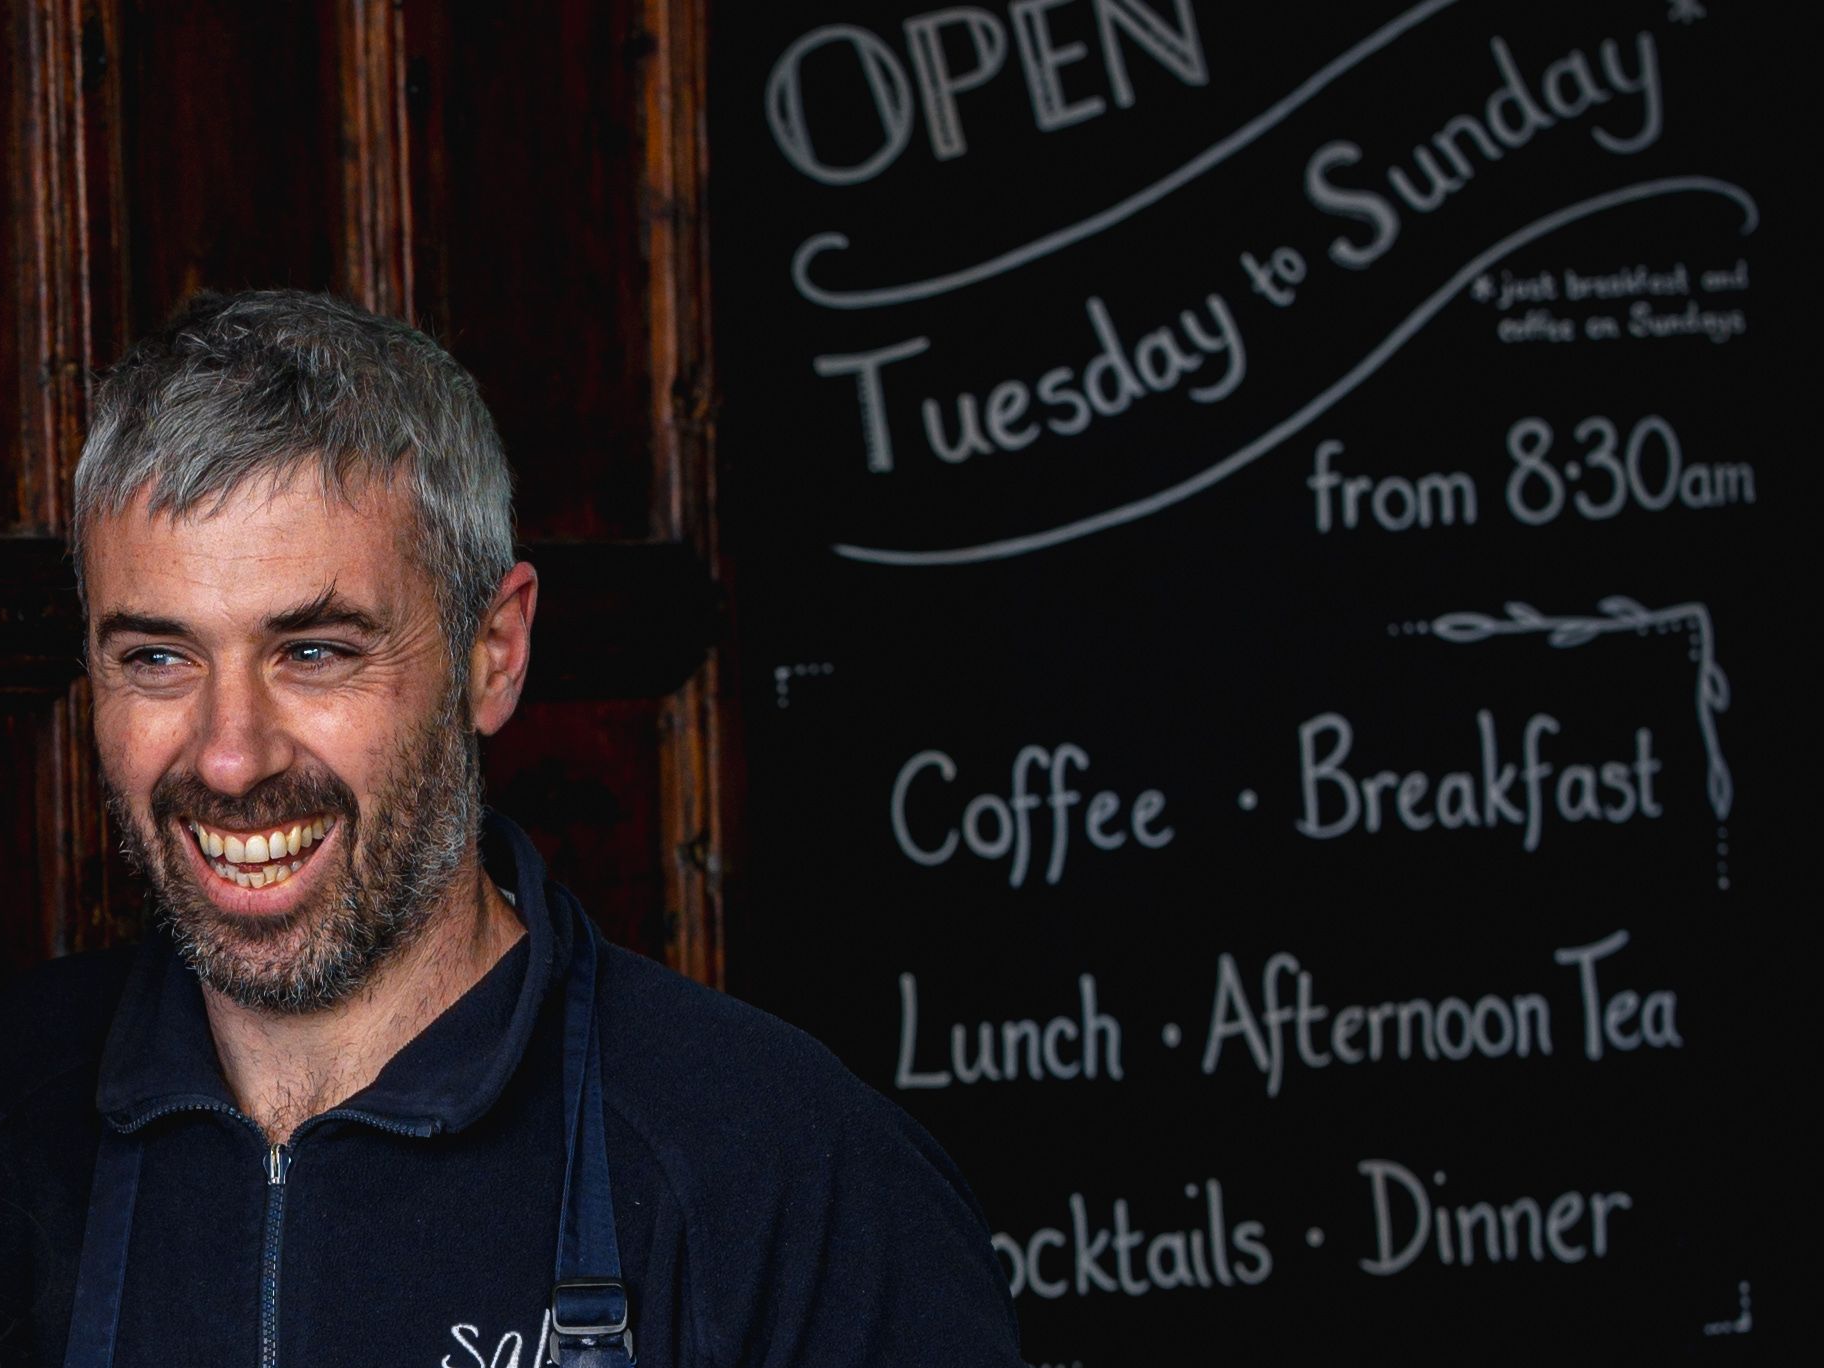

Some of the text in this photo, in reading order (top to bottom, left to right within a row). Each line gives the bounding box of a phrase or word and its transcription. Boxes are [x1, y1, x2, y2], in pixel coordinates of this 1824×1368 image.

[766, 0, 1208, 185] OPEN
[813, 295, 1246, 472] Tuesday
[1241, 248, 1306, 306] to
[1307, 440, 1477, 532] from
[891, 709, 1663, 887] Coffee Breakfast
[895, 930, 1683, 1097] Lunch Afternoon Tea
[991, 1160, 1633, 1298] ocktails Dinner
